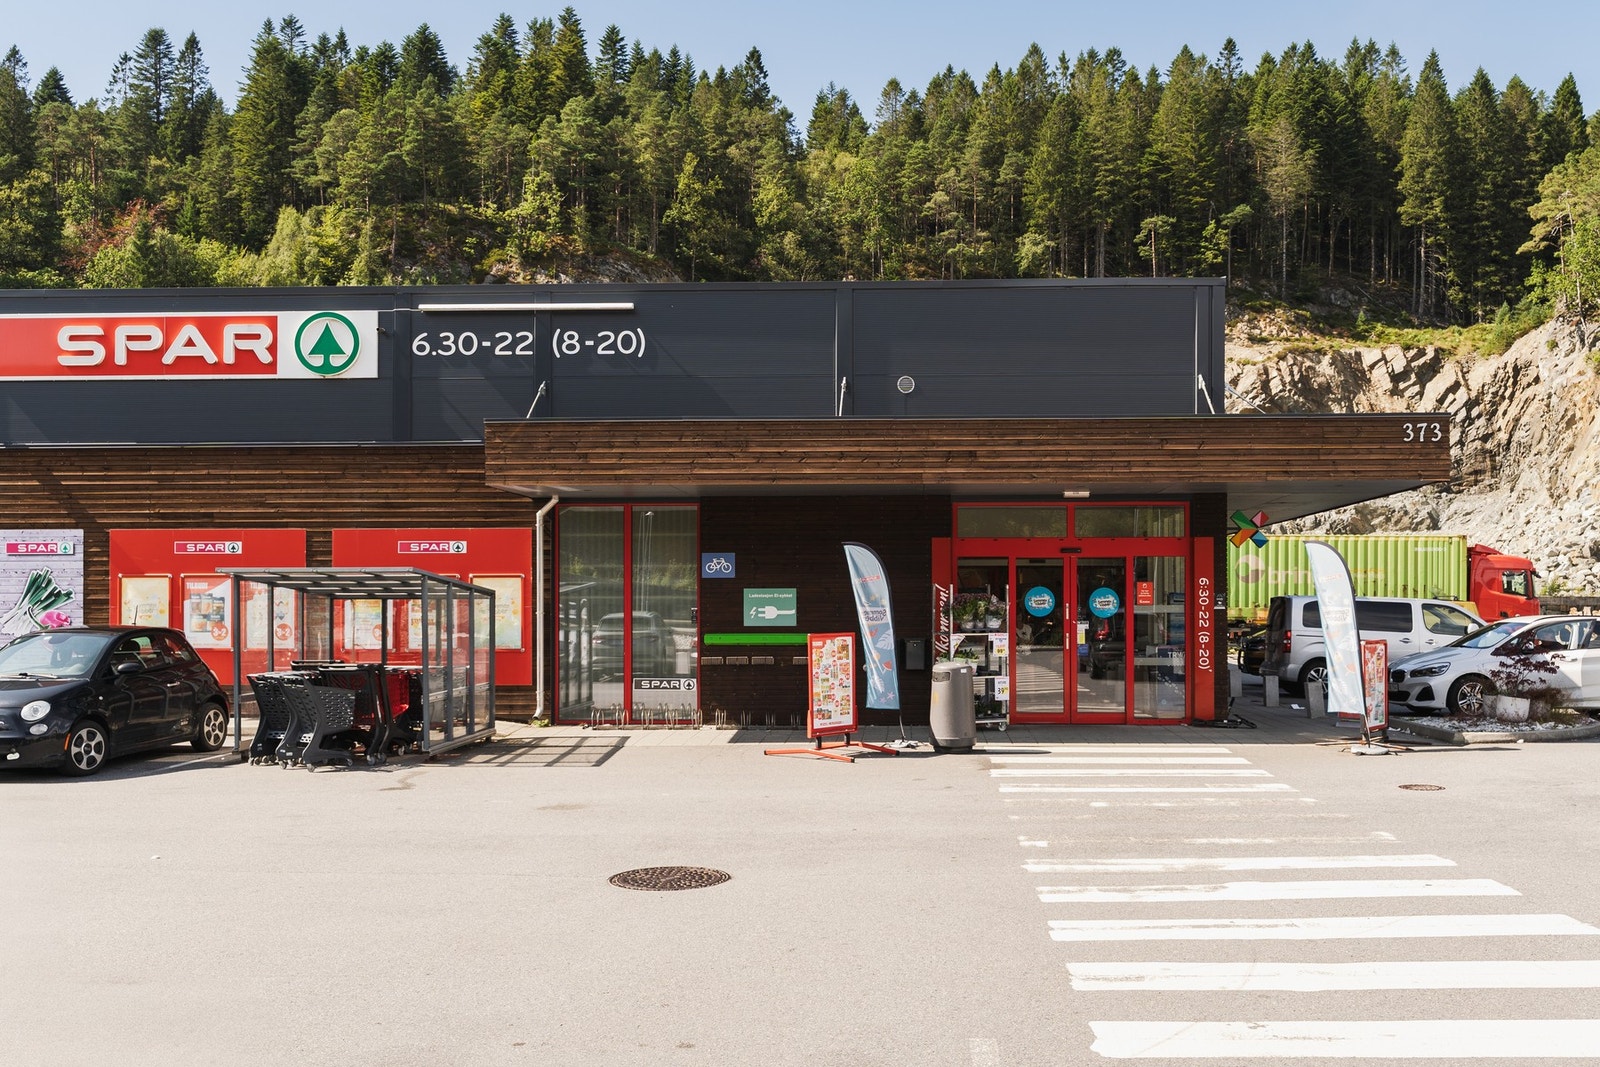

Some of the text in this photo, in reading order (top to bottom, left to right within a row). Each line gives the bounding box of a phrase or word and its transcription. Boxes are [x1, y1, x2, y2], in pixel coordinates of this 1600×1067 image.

[57, 324, 273, 366] SPAR
[411, 327, 646, 358] 6.30-22 (8-20)
[1403, 422, 1442, 442] 373
[17, 543, 57, 552] SPAR
[186, 543, 225, 552] SPAR
[410, 543, 449, 551] SPAR
[1267, 566, 1312, 584] brin
[1198, 577, 1210, 628] 6:30-22
[641, 680, 680, 688] SPAR
